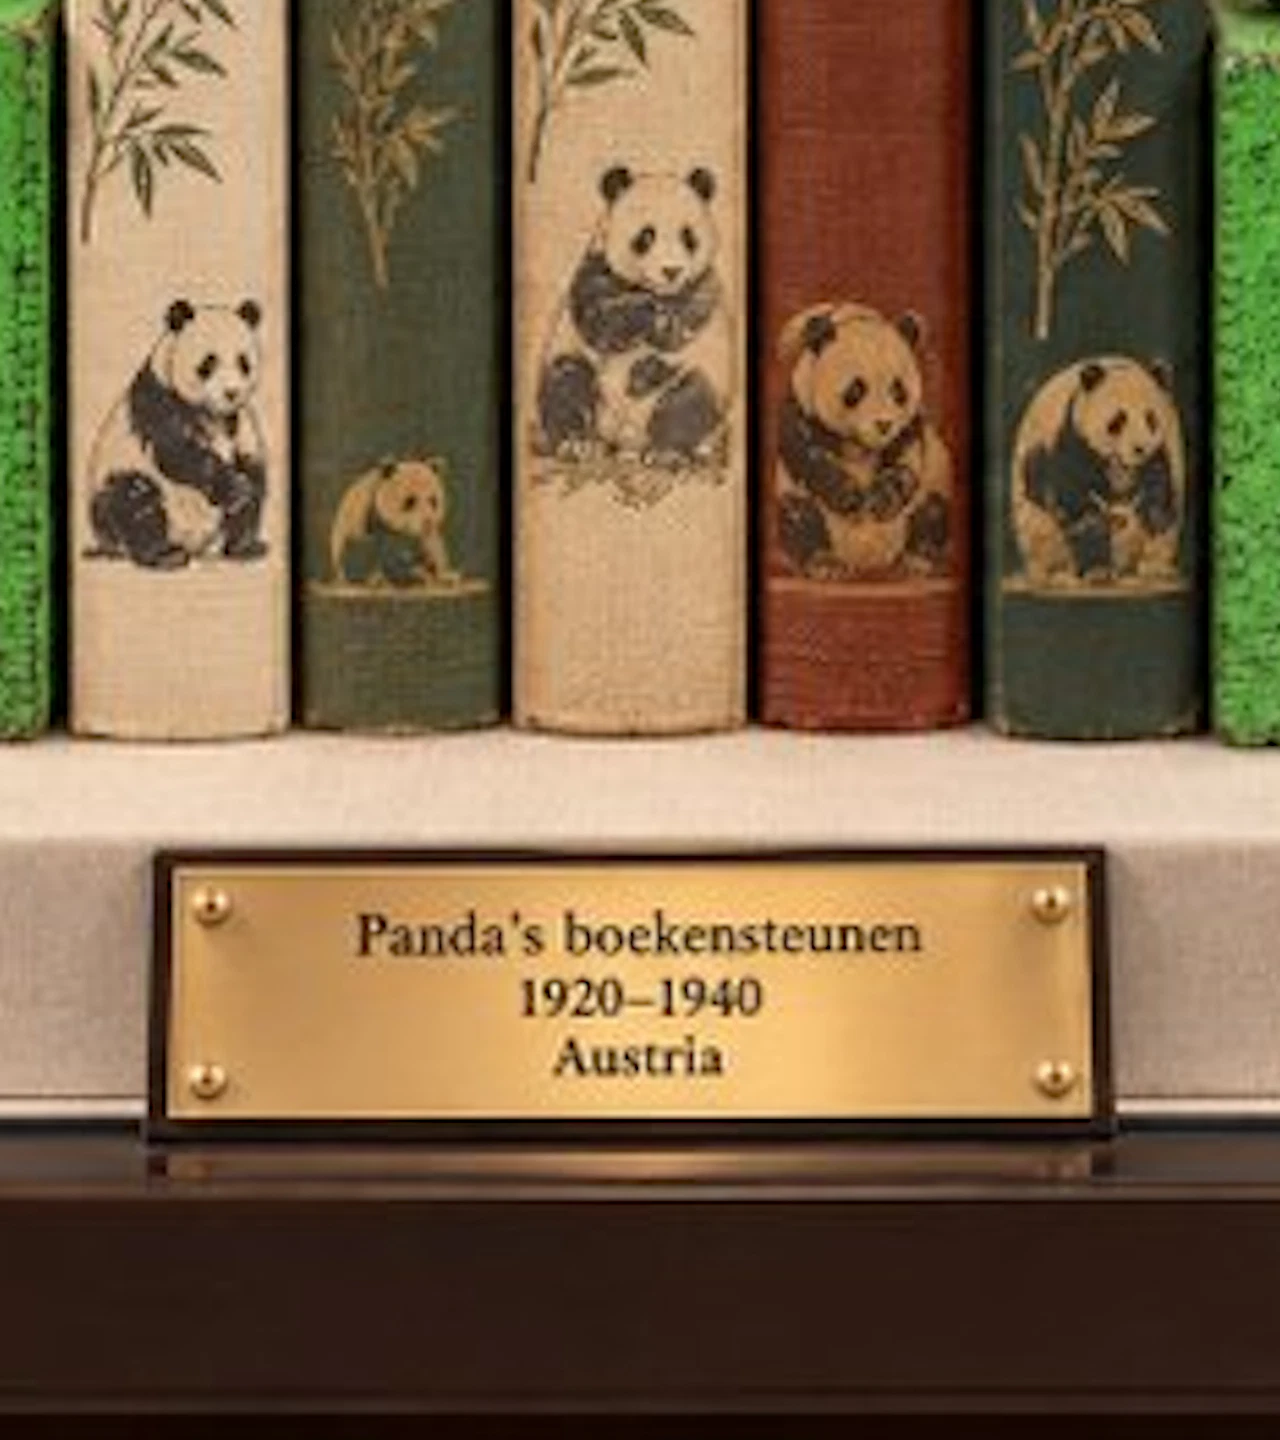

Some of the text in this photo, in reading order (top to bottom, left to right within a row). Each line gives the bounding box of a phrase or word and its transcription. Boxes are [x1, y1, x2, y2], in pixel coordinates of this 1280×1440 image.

[355, 911, 923, 959] Panda's boekensteunen
[552, 1033, 724, 1079] Austria
